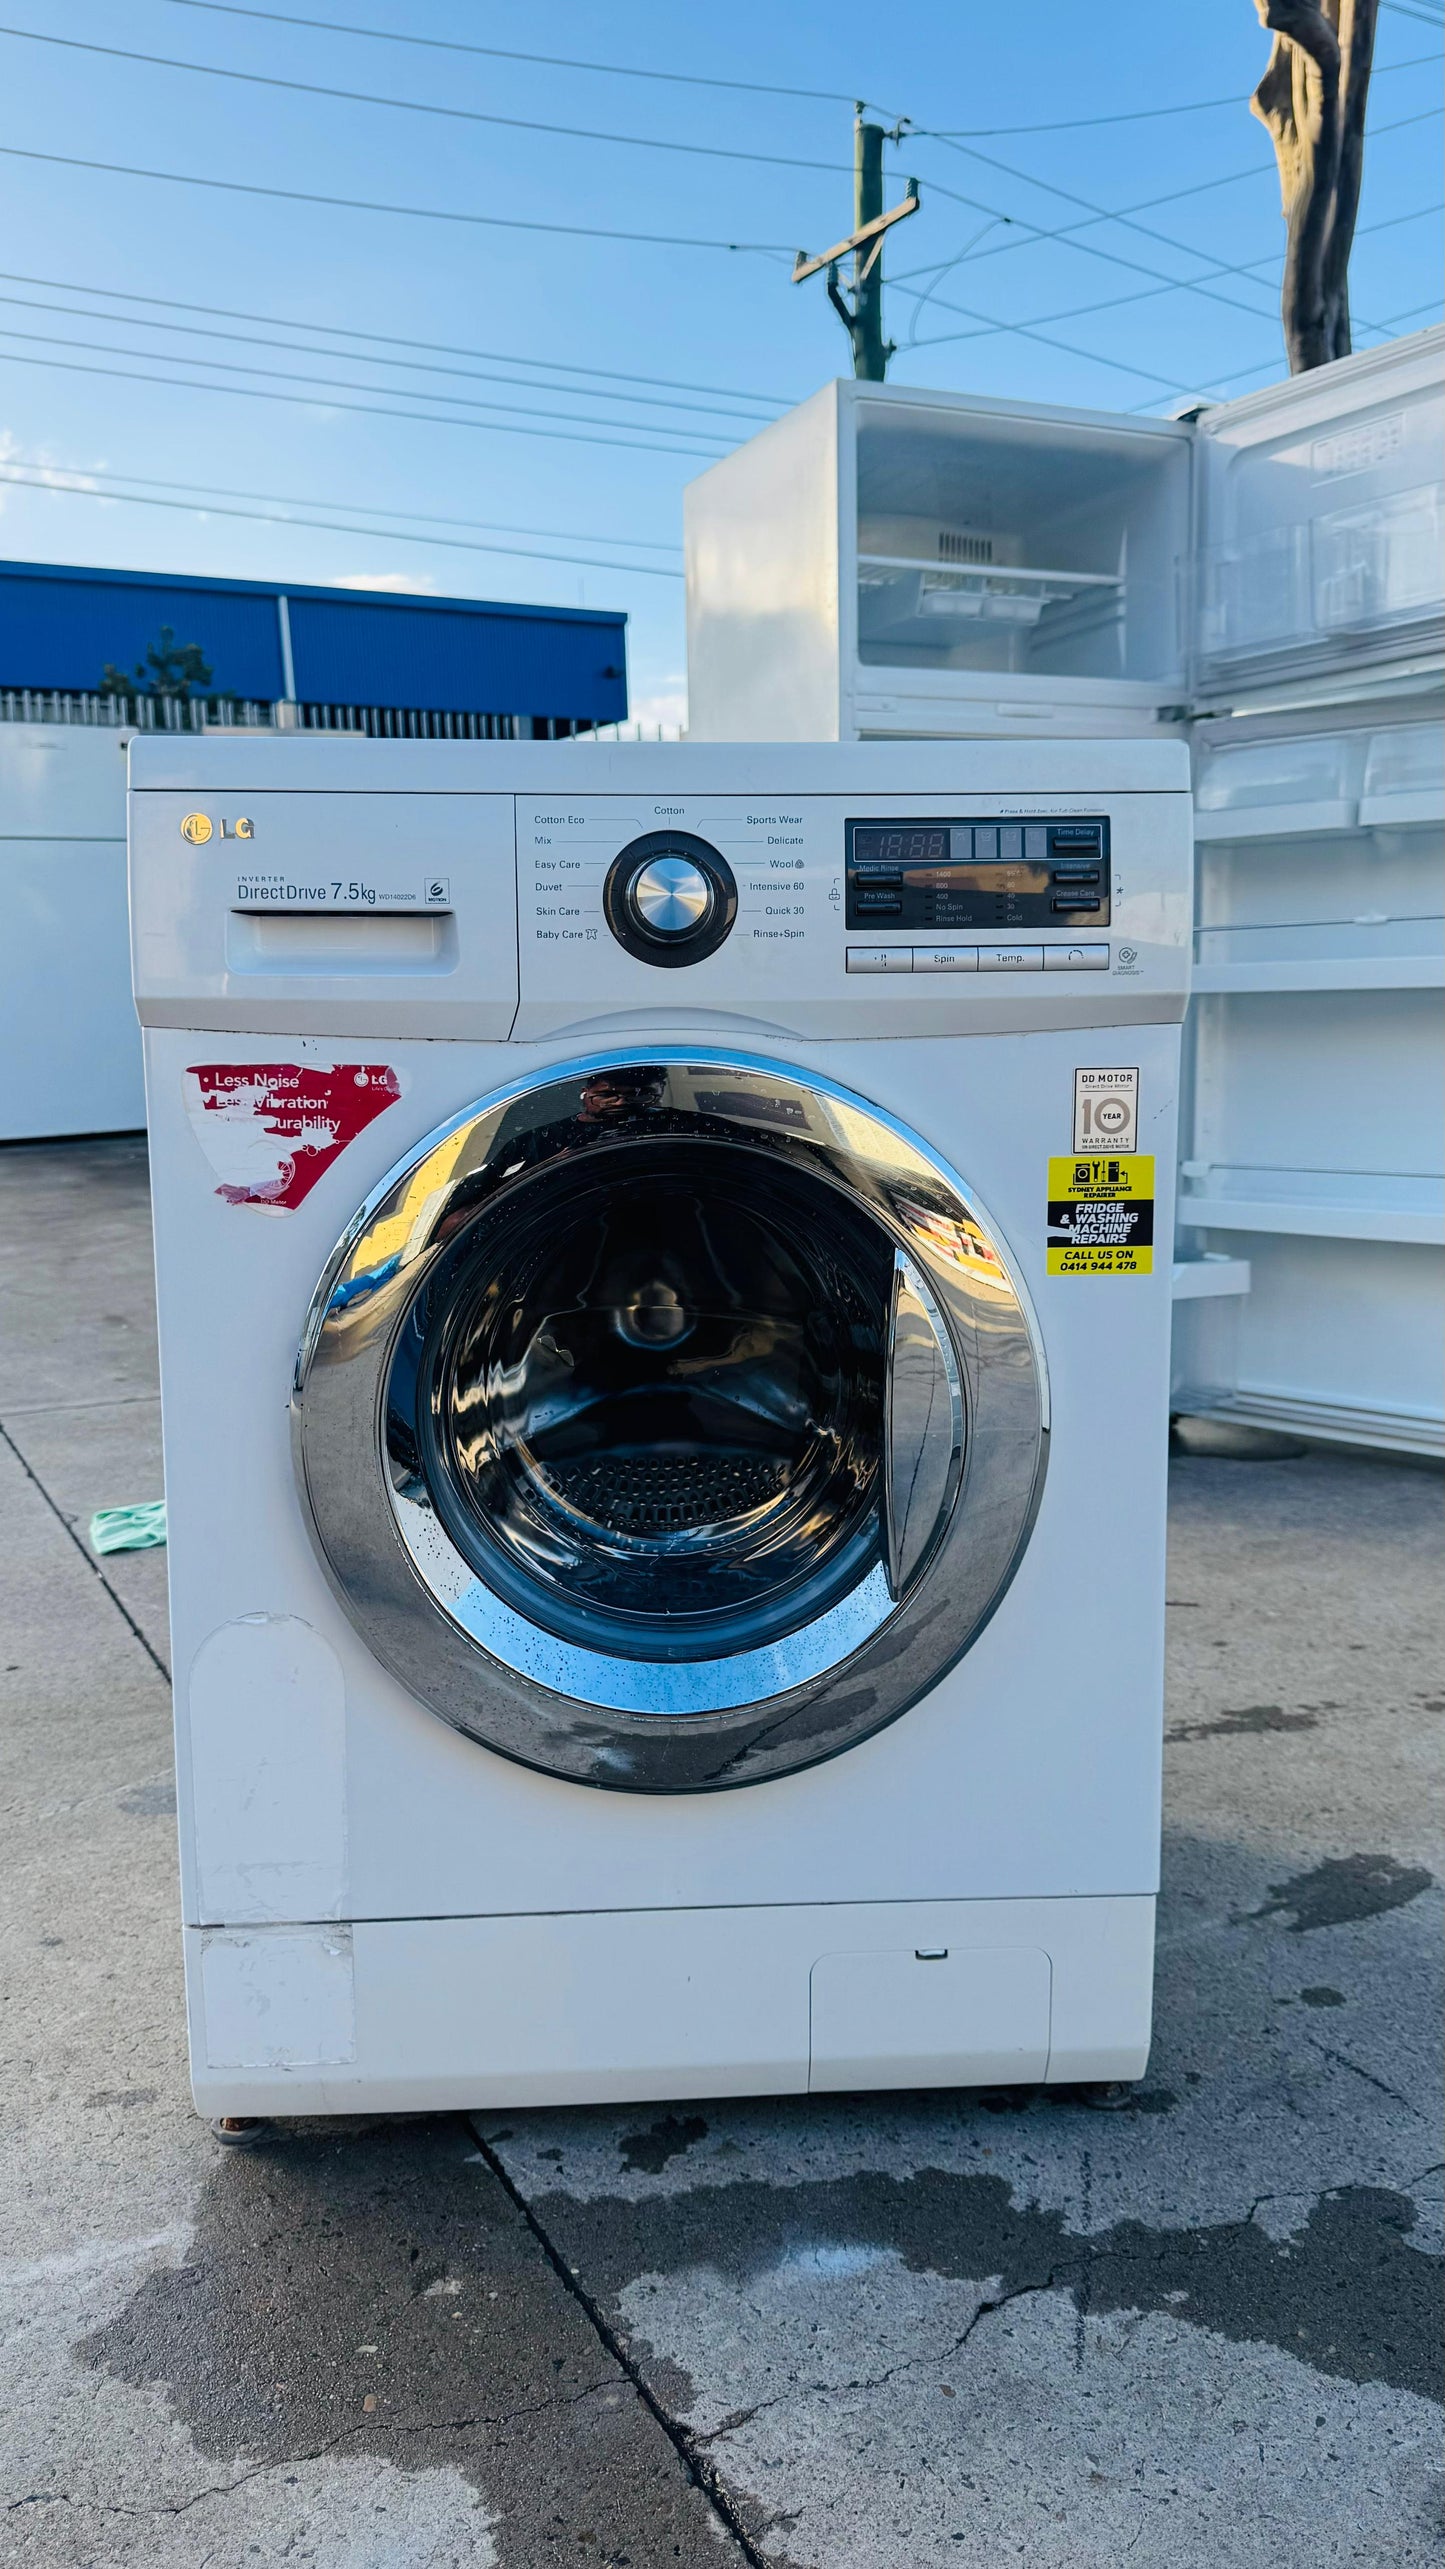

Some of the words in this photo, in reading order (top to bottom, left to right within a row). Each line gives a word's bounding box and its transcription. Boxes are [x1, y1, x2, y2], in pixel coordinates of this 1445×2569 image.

[654, 806, 684, 814] Cotton
[534, 816, 565, 824] Cotton
[568, 816, 584, 824] Eco
[746, 816, 776, 826] Sports
[779, 816, 802, 824] Wear
[220, 818, 255, 839] LG
[534, 836, 552, 845] Mix
[768, 836, 803, 844] Delicate
[535, 860, 557, 870] Easy
[560, 860, 580, 868] Care
[770, 860, 794, 868] Wool
[536, 882, 562, 892] Duvet
[750, 882, 790, 890] Intensive
[793, 882, 804, 890] 60
[331, 882, 376, 904] 7.5kg
[536, 907, 556, 915] Skin
[558, 907, 580, 916] Care
[765, 906, 790, 915] Quick
[793, 907, 804, 915] 30
[536, 930, 558, 940] Baby
[562, 930, 583, 938] Care
[754, 930, 804, 939] Rinse+Spin
[934, 954, 955, 963] Spin
[997, 953, 1024, 963] Temp.
[215, 1072, 249, 1086] Less
[254, 1073, 299, 1088] Noise
[372, 1075, 387, 1084] LG
[1098, 1074, 1132, 1082] MOTOR
[1082, 1098, 1130, 1134] 10
[276, 1115, 340, 1133] urability
[1076, 1203, 1124, 1213] FRIDGE
[1060, 1214, 1070, 1224] &
[1076, 1213, 1138, 1223] WASHING
[1069, 1224, 1132, 1234] MACHINE
[1072, 1234, 1127, 1244] REPAIRS
[1065, 1252, 1094, 1260] CALL
[1098, 1251, 1112, 1259] US
[1091, 1262, 1112, 1270] 944
[1116, 1262, 1137, 1270] 478
